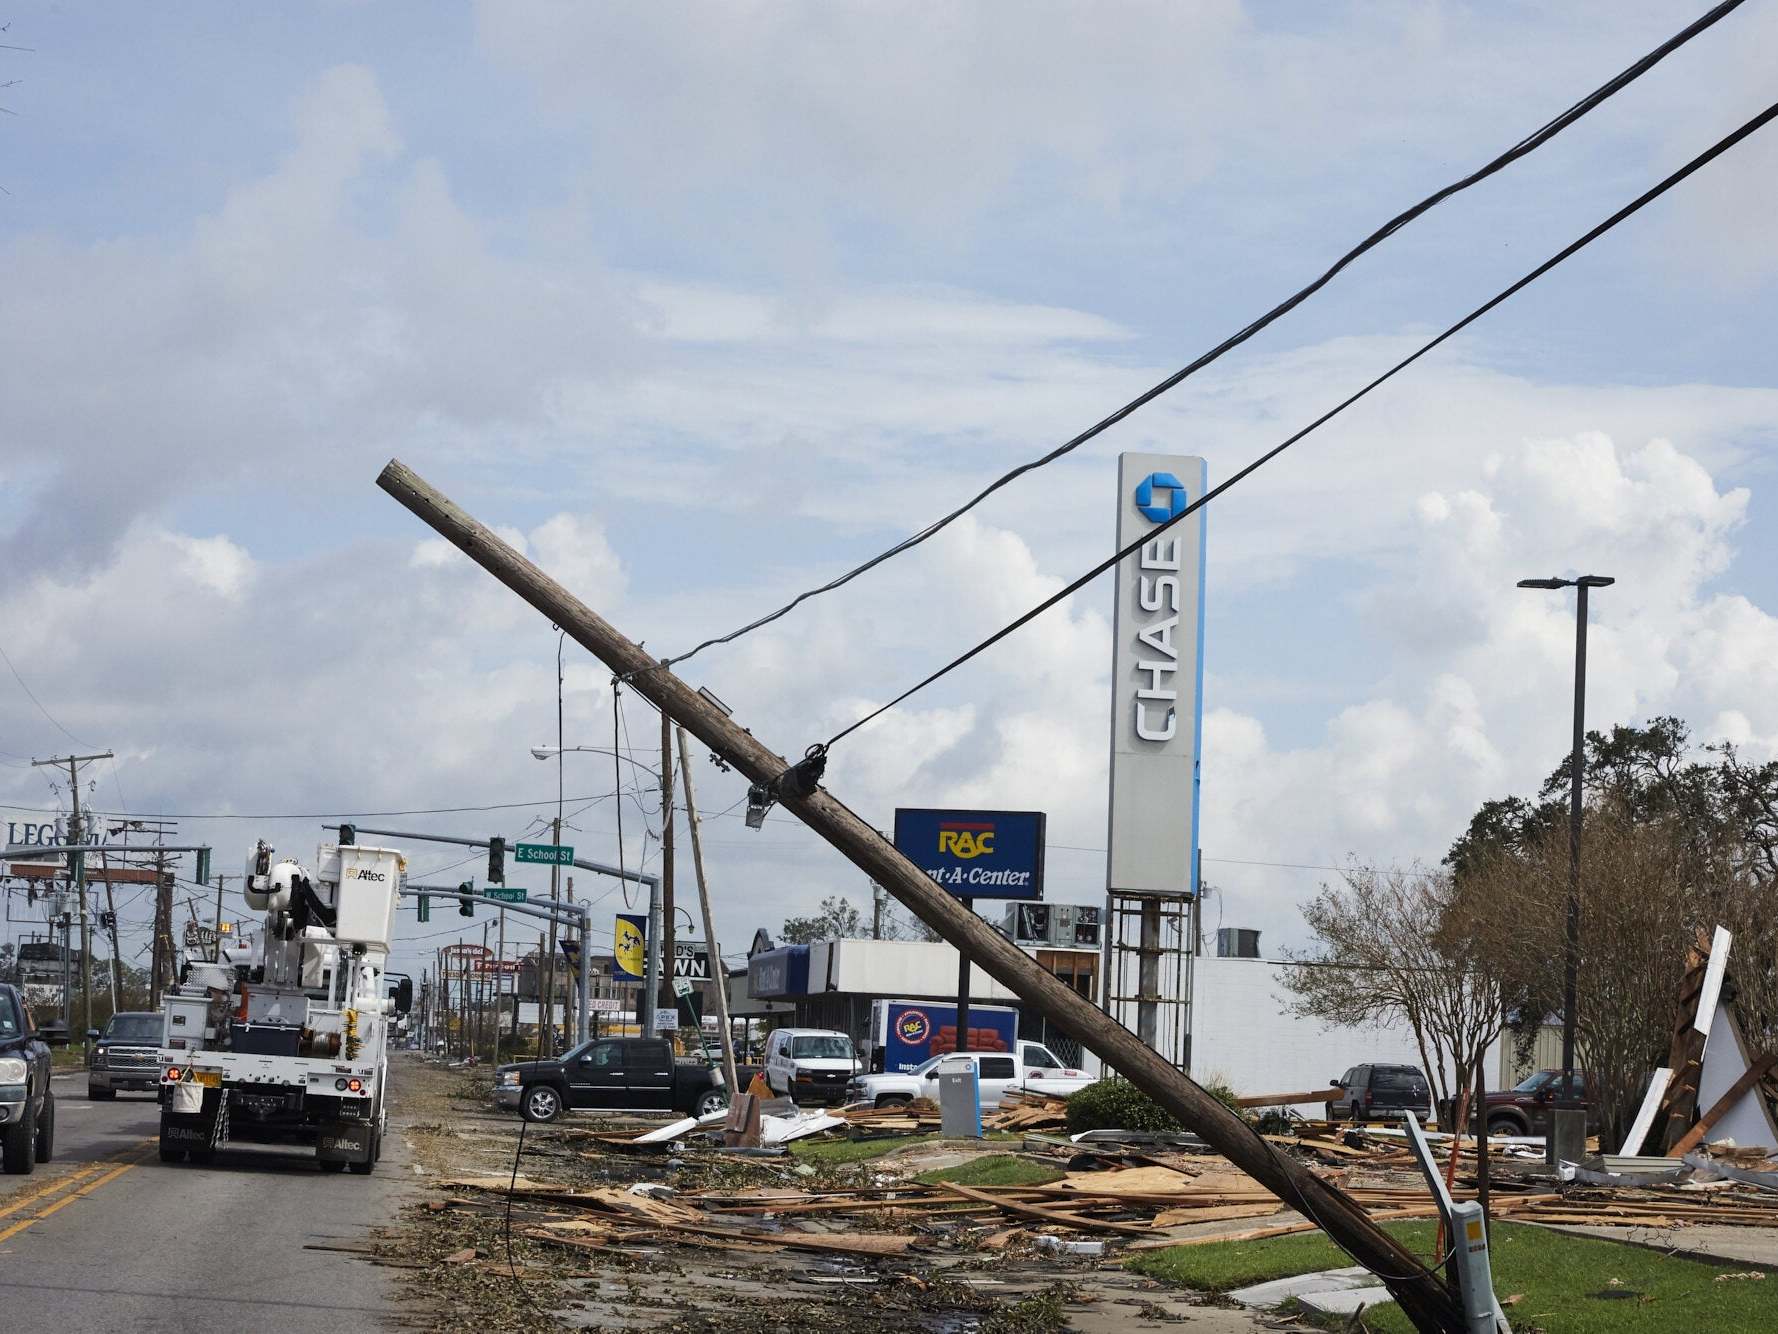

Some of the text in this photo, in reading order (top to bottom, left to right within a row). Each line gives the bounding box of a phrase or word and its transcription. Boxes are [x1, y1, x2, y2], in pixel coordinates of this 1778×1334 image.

[1136, 533, 1182, 741] CHASE
[938, 831, 995, 859] RAC
[517, 847, 570, 861] E School St
[358, 869, 385, 882] Altec
[493, 891, 515, 900] School
[517, 891, 524, 900] St
[903, 1021, 922, 1033] RAC
[334, 1138, 361, 1151] Altec
